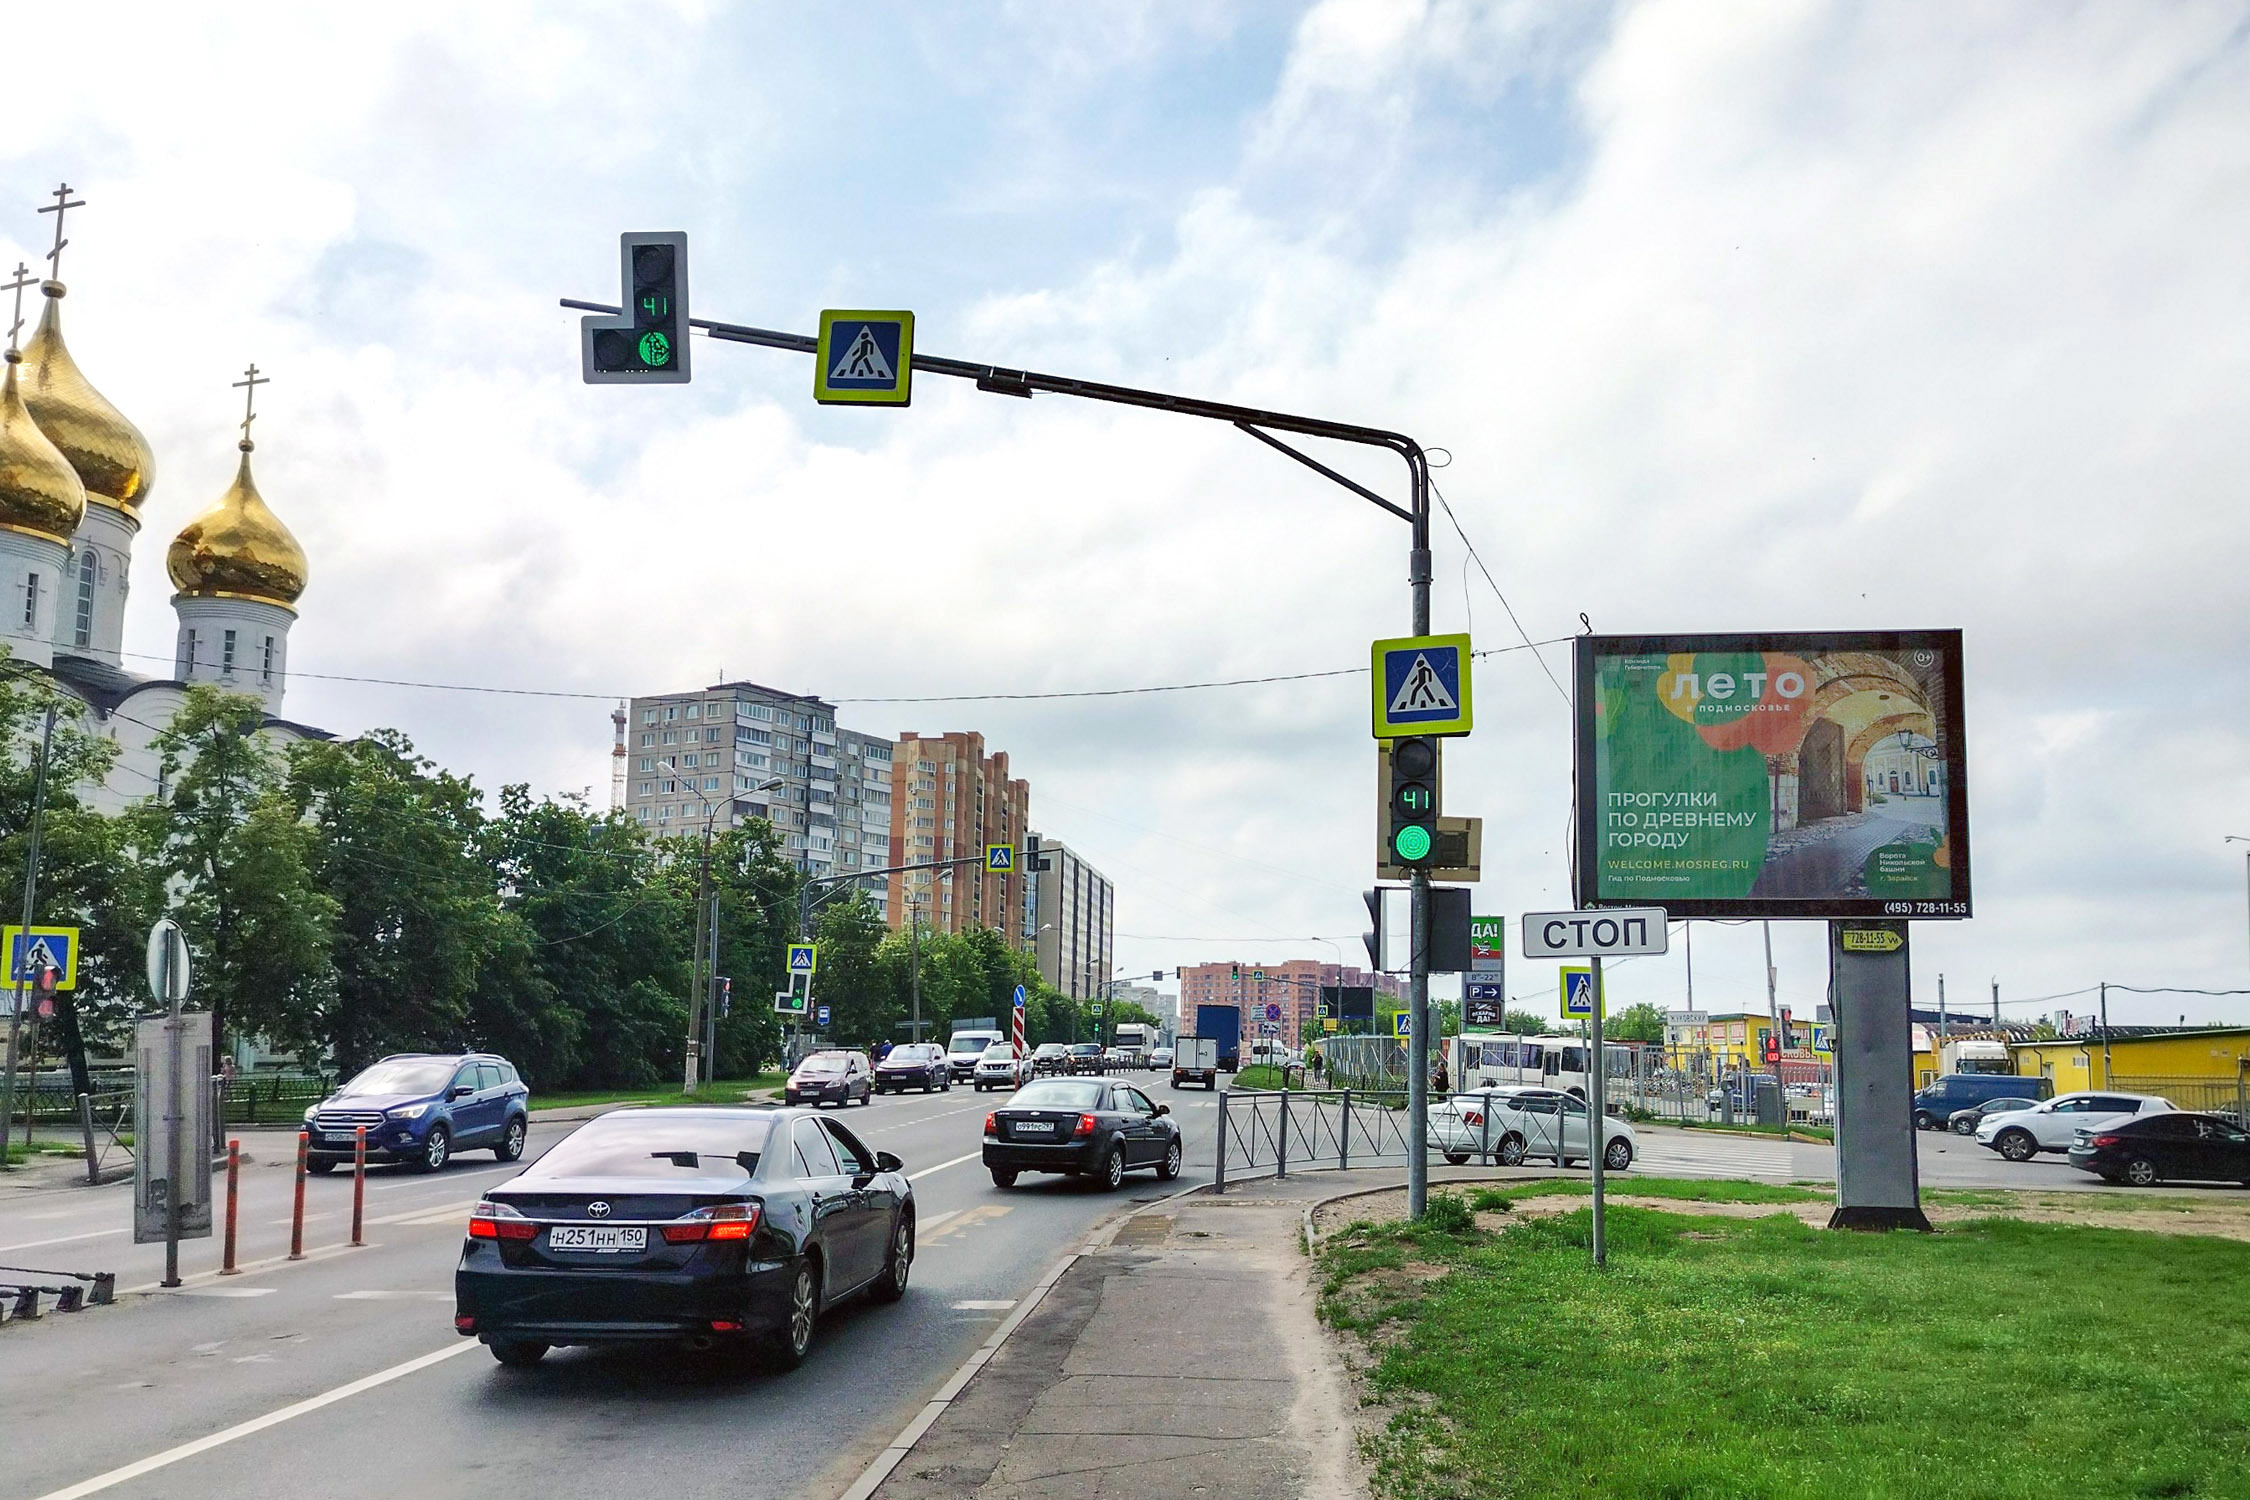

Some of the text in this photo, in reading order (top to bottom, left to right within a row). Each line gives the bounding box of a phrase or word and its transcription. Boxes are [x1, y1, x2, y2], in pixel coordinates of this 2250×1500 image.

[643, 297, 667, 316] 41
[1403, 790, 1429, 809] 41
[1608, 792, 1717, 807] ПРОГУЛКИ
[1608, 812, 1757, 829] ПО ДРЕВНЕМУ
[1608, 832, 1690, 849] ГОРОДУ
[1879, 852, 1906, 860] Ворота
[1608, 860, 1749, 869] WELCOME.MOSREG.RU
[1884, 902, 1967, 914] (495) 728-11-55
[1543, 918, 1647, 949] СТОП
[620, 1229, 642, 1242] 150
